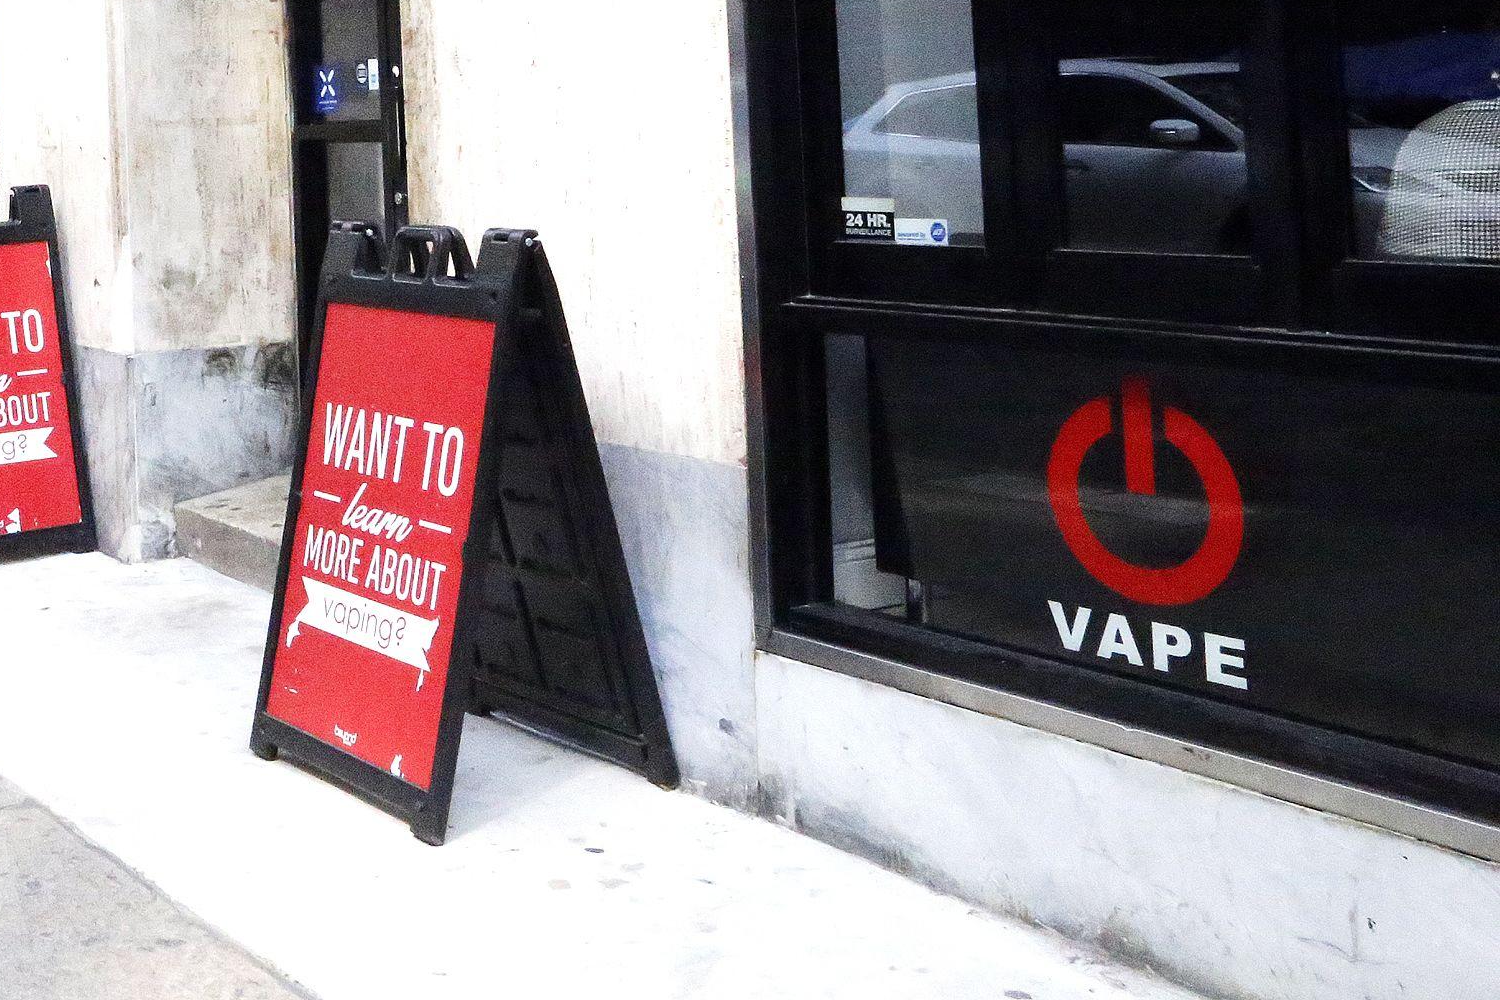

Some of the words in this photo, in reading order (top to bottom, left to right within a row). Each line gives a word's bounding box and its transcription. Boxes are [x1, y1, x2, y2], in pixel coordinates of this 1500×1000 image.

[845, 227, 892, 237] SURVEILLANCE
[846, 213, 863, 227] 24
[867, 213, 891, 228] HR.
[0, 308, 45, 355] TO
[322, 401, 415, 484] WANT
[421, 421, 465, 497] TO
[341, 481, 414, 543] learn
[303, 523, 365, 585] MORE
[364, 544, 448, 611] ABOUT
[322, 596, 407, 649] vaping?
[1047, 599, 1249, 690] VAPE
